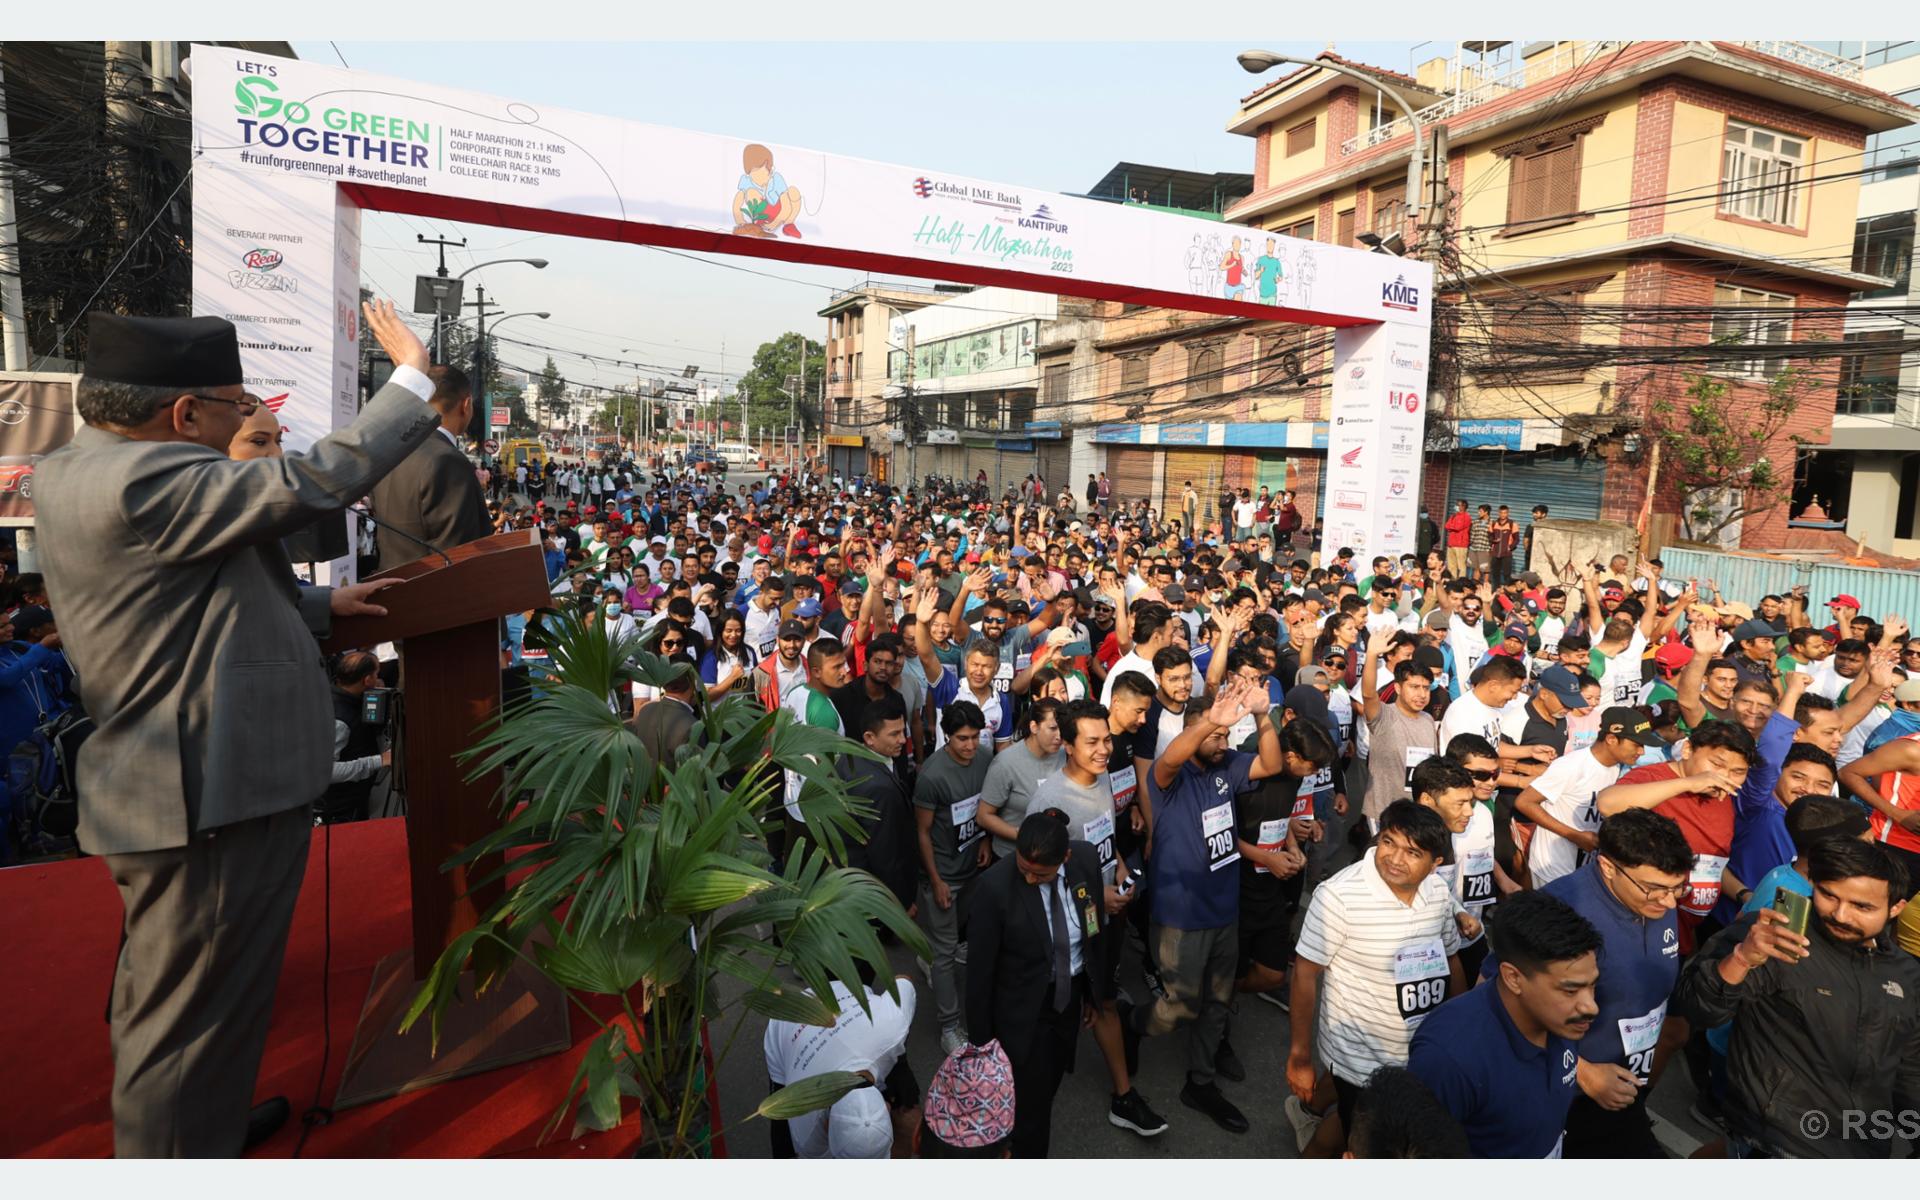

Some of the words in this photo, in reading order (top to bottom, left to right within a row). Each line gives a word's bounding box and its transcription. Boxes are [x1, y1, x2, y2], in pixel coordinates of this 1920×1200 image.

[236, 60, 278, 77] LET'S
[323, 107, 430, 143] GREEN
[237, 118, 429, 169] TOGETHER
[450, 128, 473, 139] HALF
[475, 132, 524, 148] MARATHON
[526, 140, 544, 150] 21.1
[546, 143, 566, 154] KMS
[450, 140, 502, 157] CORPORATE
[504, 148, 522, 159] RUN
[525, 152, 531, 161] 5
[532, 153, 552, 164] KMS
[240, 150, 344, 176] #runforgreennepal
[347, 165, 427, 187] #savetheplanet
[450, 153, 507, 169] WHEELCHAIR
[509, 161, 532, 173] RACE
[534, 165, 540, 174] 3
[541, 166, 561, 177] KMS
[450, 165, 489, 179] COLLEGE
[491, 170, 510, 182] RUN
[512, 174, 518, 183] 7
[520, 175, 540, 186] KMS
[934, 182, 968, 197] Global
[972, 187, 993, 200] IME
[997, 192, 1022, 205] Bank
[226, 228, 267, 241] BEVERAGE
[269, 233, 303, 244] PARTNER
[1018, 217, 1068, 234] KANTIPUR
[248, 251, 279, 268] Real
[1051, 261, 1073, 273] 2023
[1382, 282, 1418, 305] KMG
[225, 313, 268, 325] COMMERCE
[269, 316, 301, 326] PARTNER
[265, 378, 297, 387] PARTNER
[1317, 766, 1332, 784] 35
[959, 819, 978, 840] 49
[1098, 838, 1112, 864] 20
[1208, 830, 1234, 860] 209
[1468, 874, 1491, 897] 728
[1402, 978, 1446, 1012] 689
